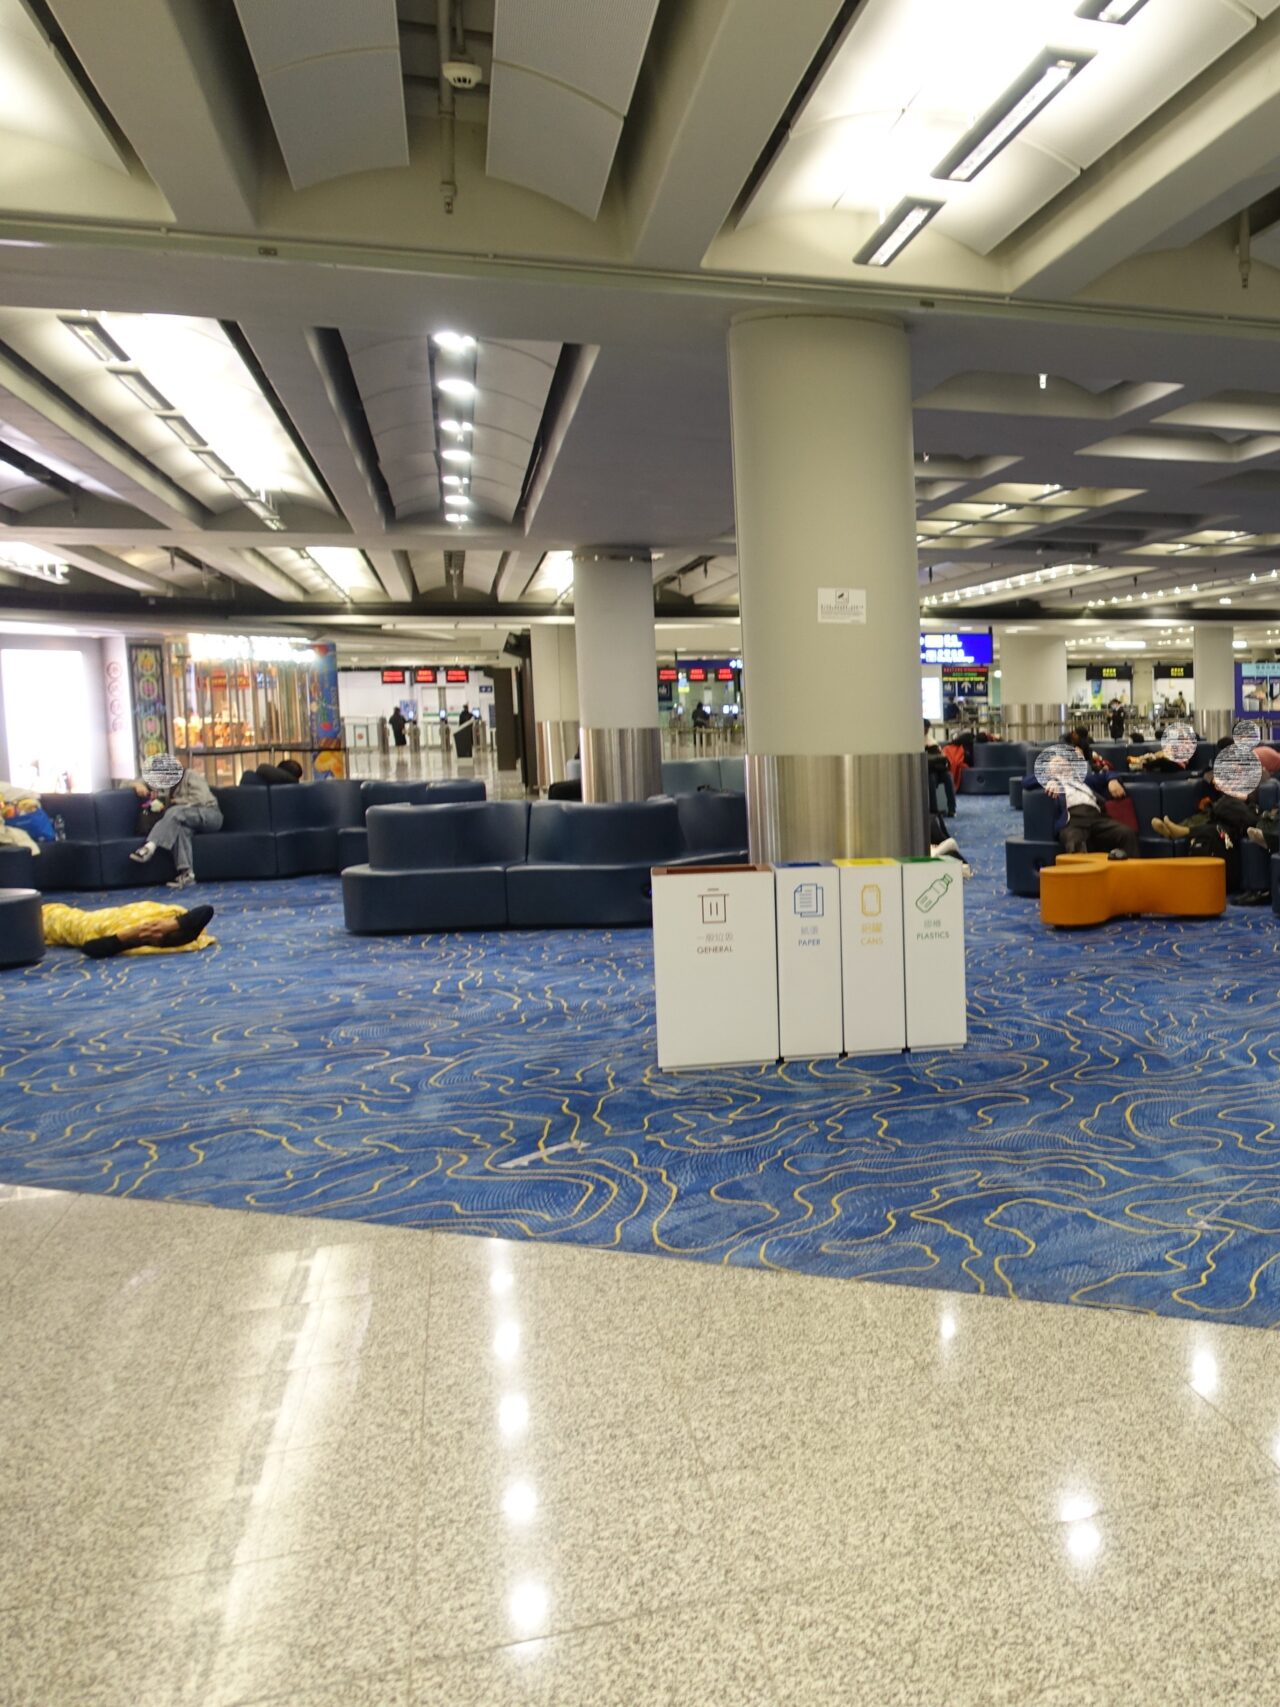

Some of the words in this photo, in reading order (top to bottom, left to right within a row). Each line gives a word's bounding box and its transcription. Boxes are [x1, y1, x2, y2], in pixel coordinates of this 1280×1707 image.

[916, 930, 950, 941] PLASTICS
[798, 938, 822, 947] PAPER
[860, 936, 884, 945] CANS
[696, 945, 735, 955] GENERAL
